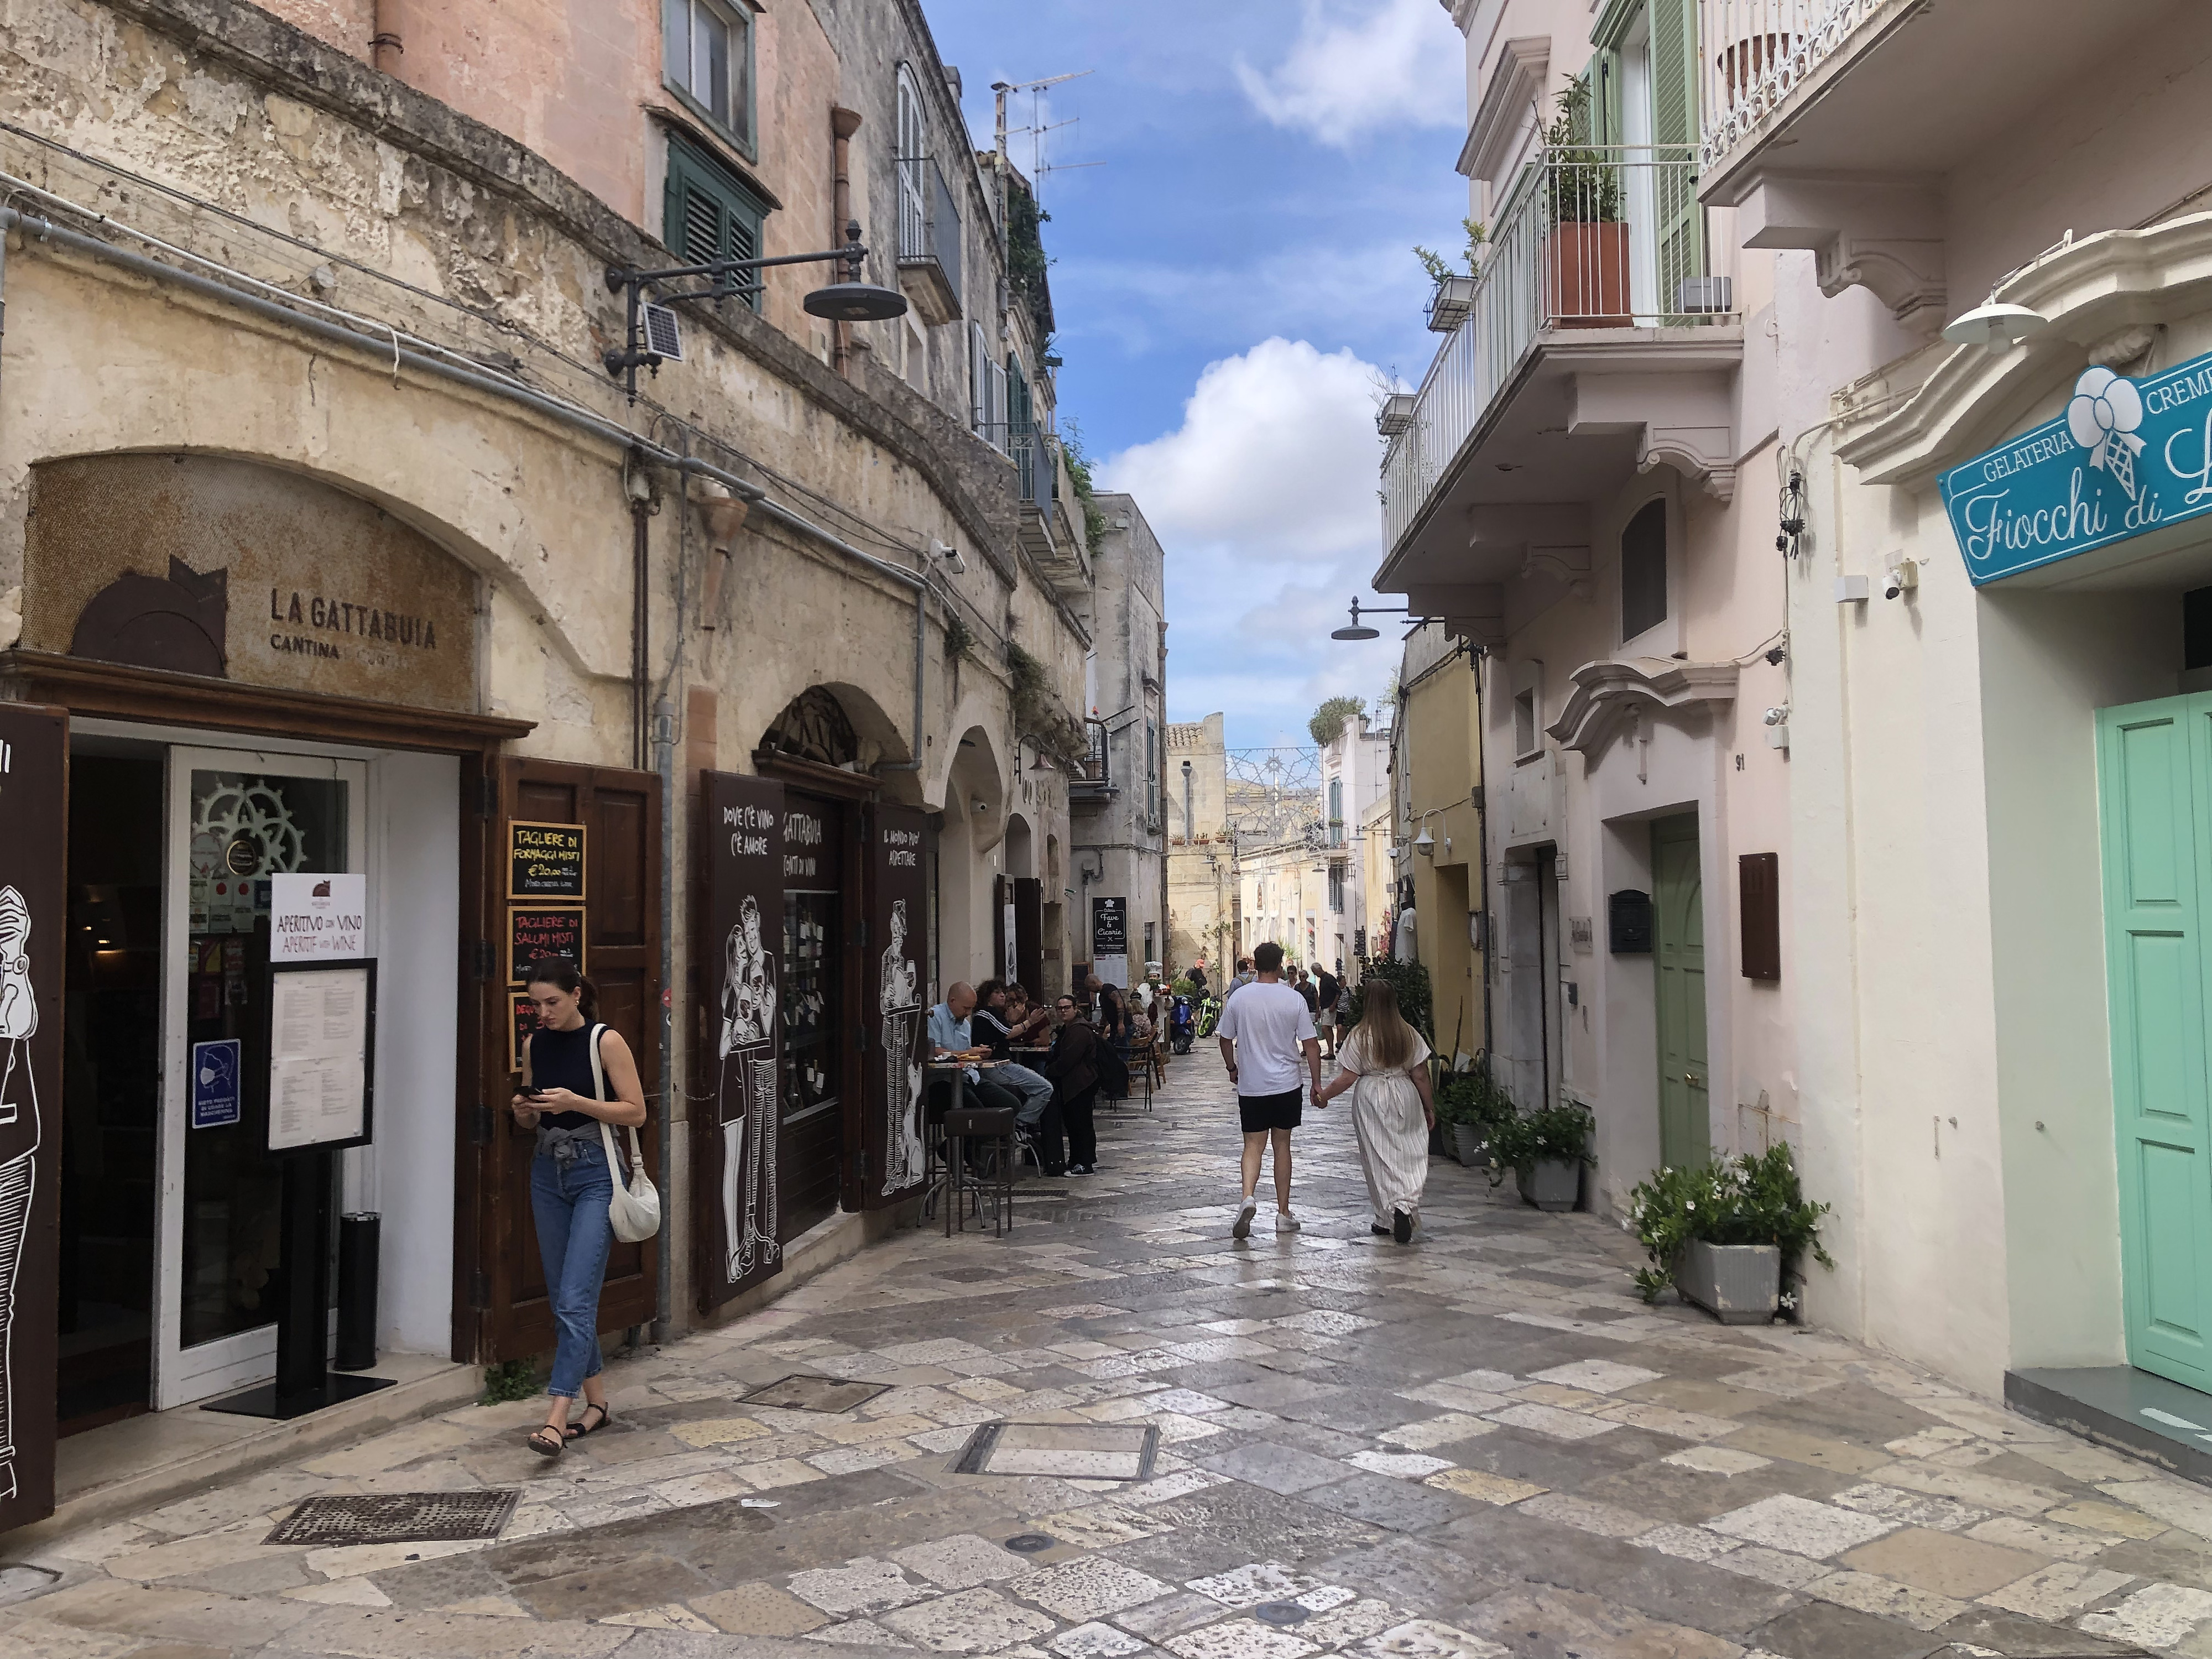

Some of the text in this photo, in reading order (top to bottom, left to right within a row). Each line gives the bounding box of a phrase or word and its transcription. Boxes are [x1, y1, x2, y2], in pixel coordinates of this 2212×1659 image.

[1983, 430, 2074, 482] GELATERIA
[1965, 467, 2107, 560] Fiocchi
[2125, 484, 2162, 529] di
[270, 588, 436, 649] LA GATTABUIA
[270, 634, 340, 660] CANTINA
[723, 806, 743, 827] DOVE
[757, 808, 774, 830] VINO
[517, 830, 577, 848] TAGLIERE DI
[743, 835, 768, 855] AMORE
[514, 848, 580, 862] FORMAGGI MISTI
[889, 849, 916, 867] ASPETTARE
[277, 915, 323, 933] APERITIVO
[337, 915, 362, 931] VINO
[515, 916, 578, 929] TAGLIERE DI
[1100, 913, 1119, 921] Fave
[514, 932, 550, 947] SALUMI
